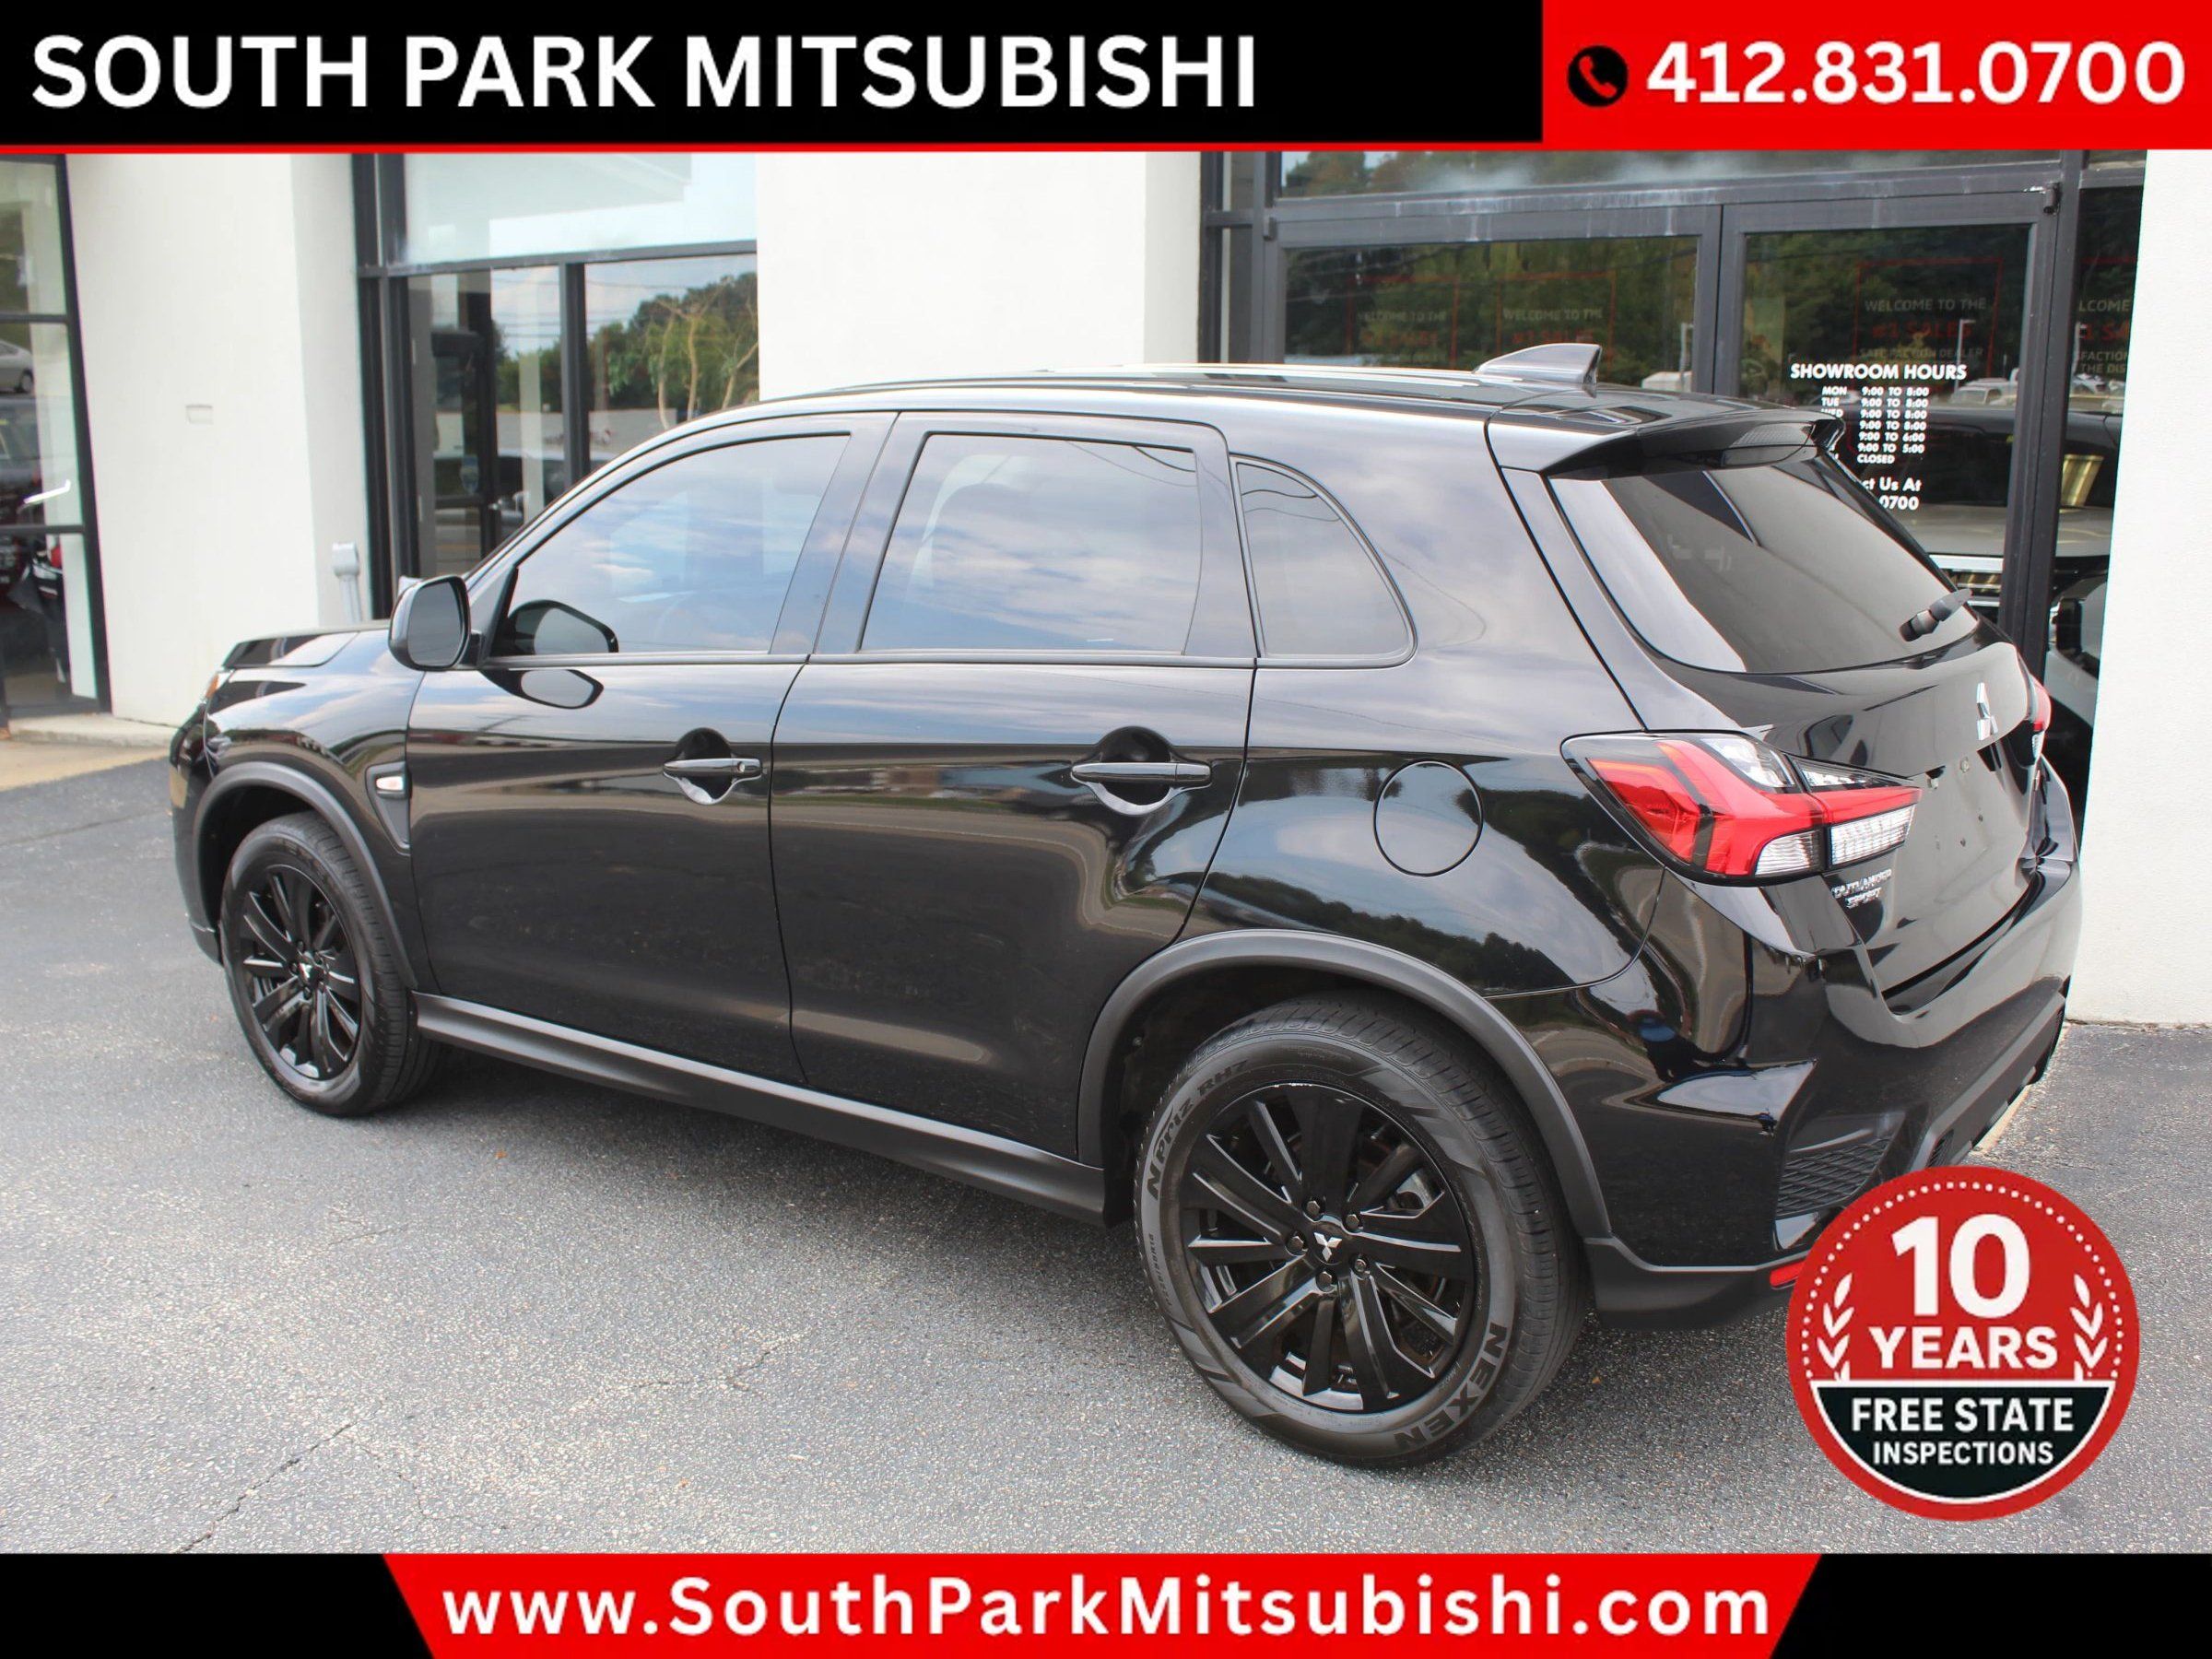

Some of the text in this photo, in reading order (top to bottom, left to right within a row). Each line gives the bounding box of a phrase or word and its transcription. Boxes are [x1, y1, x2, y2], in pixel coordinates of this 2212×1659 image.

[1864, 297, 1987, 312] WELCOME TO THE
[1790, 363, 1967, 381] SHOWROOM HOURS
[1821, 385, 1929, 397] MON 9:00 TO 8:00
[1820, 396, 1928, 408] TUE 9:00 TO 8:00
[1860, 408, 1882, 418] 9:00
[1886, 409, 1900, 419] TO
[1904, 409, 1927, 419] 8:00
[1859, 420, 1926, 431] 9:00 TO 8:00
[1858, 431, 1925, 442] 9:00 TO 6:00
[1857, 442, 1925, 453] 9:00 TO 5:00
[1856, 453, 1895, 465] CLOSED
[1879, 477, 1899, 491] Us
[1902, 477, 1923, 492] At
[1394, 1321, 1508, 1453] NEXEN
